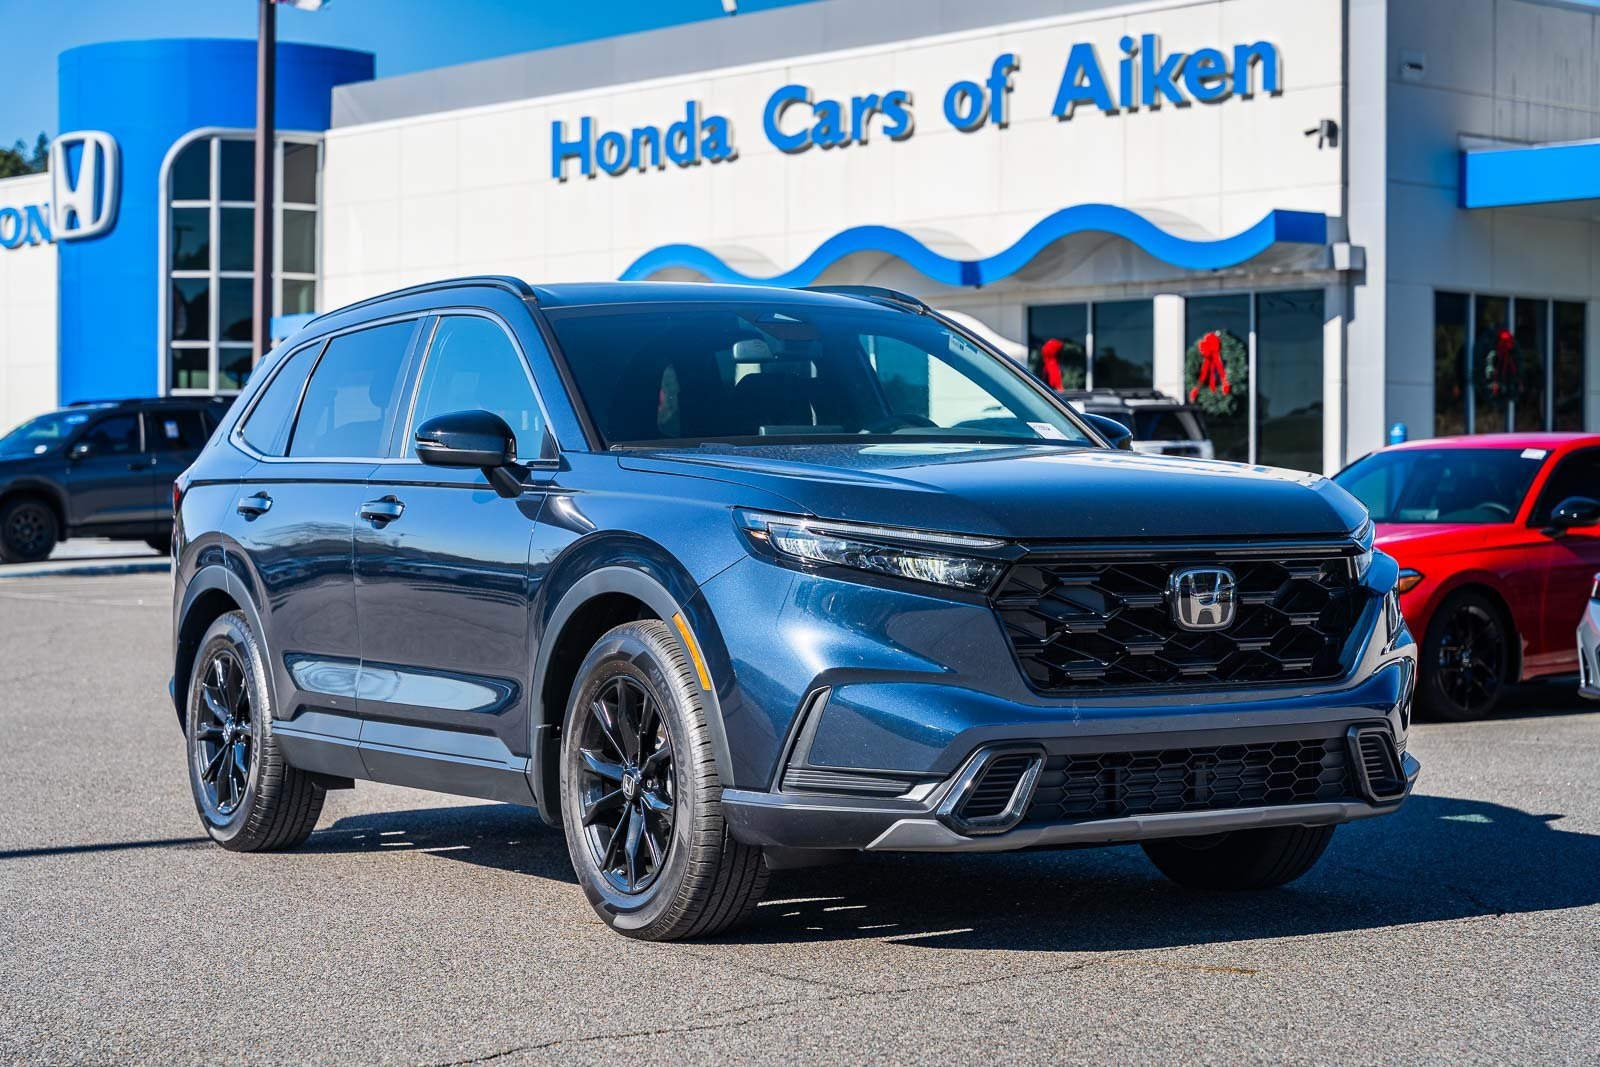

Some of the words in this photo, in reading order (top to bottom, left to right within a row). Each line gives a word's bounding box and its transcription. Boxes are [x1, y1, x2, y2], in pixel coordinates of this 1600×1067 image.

[551, 100, 735, 181] Honda
[763, 85, 911, 153] Cars
[944, 53, 1018, 132] of
[1051, 34, 1282, 120] Aiken
